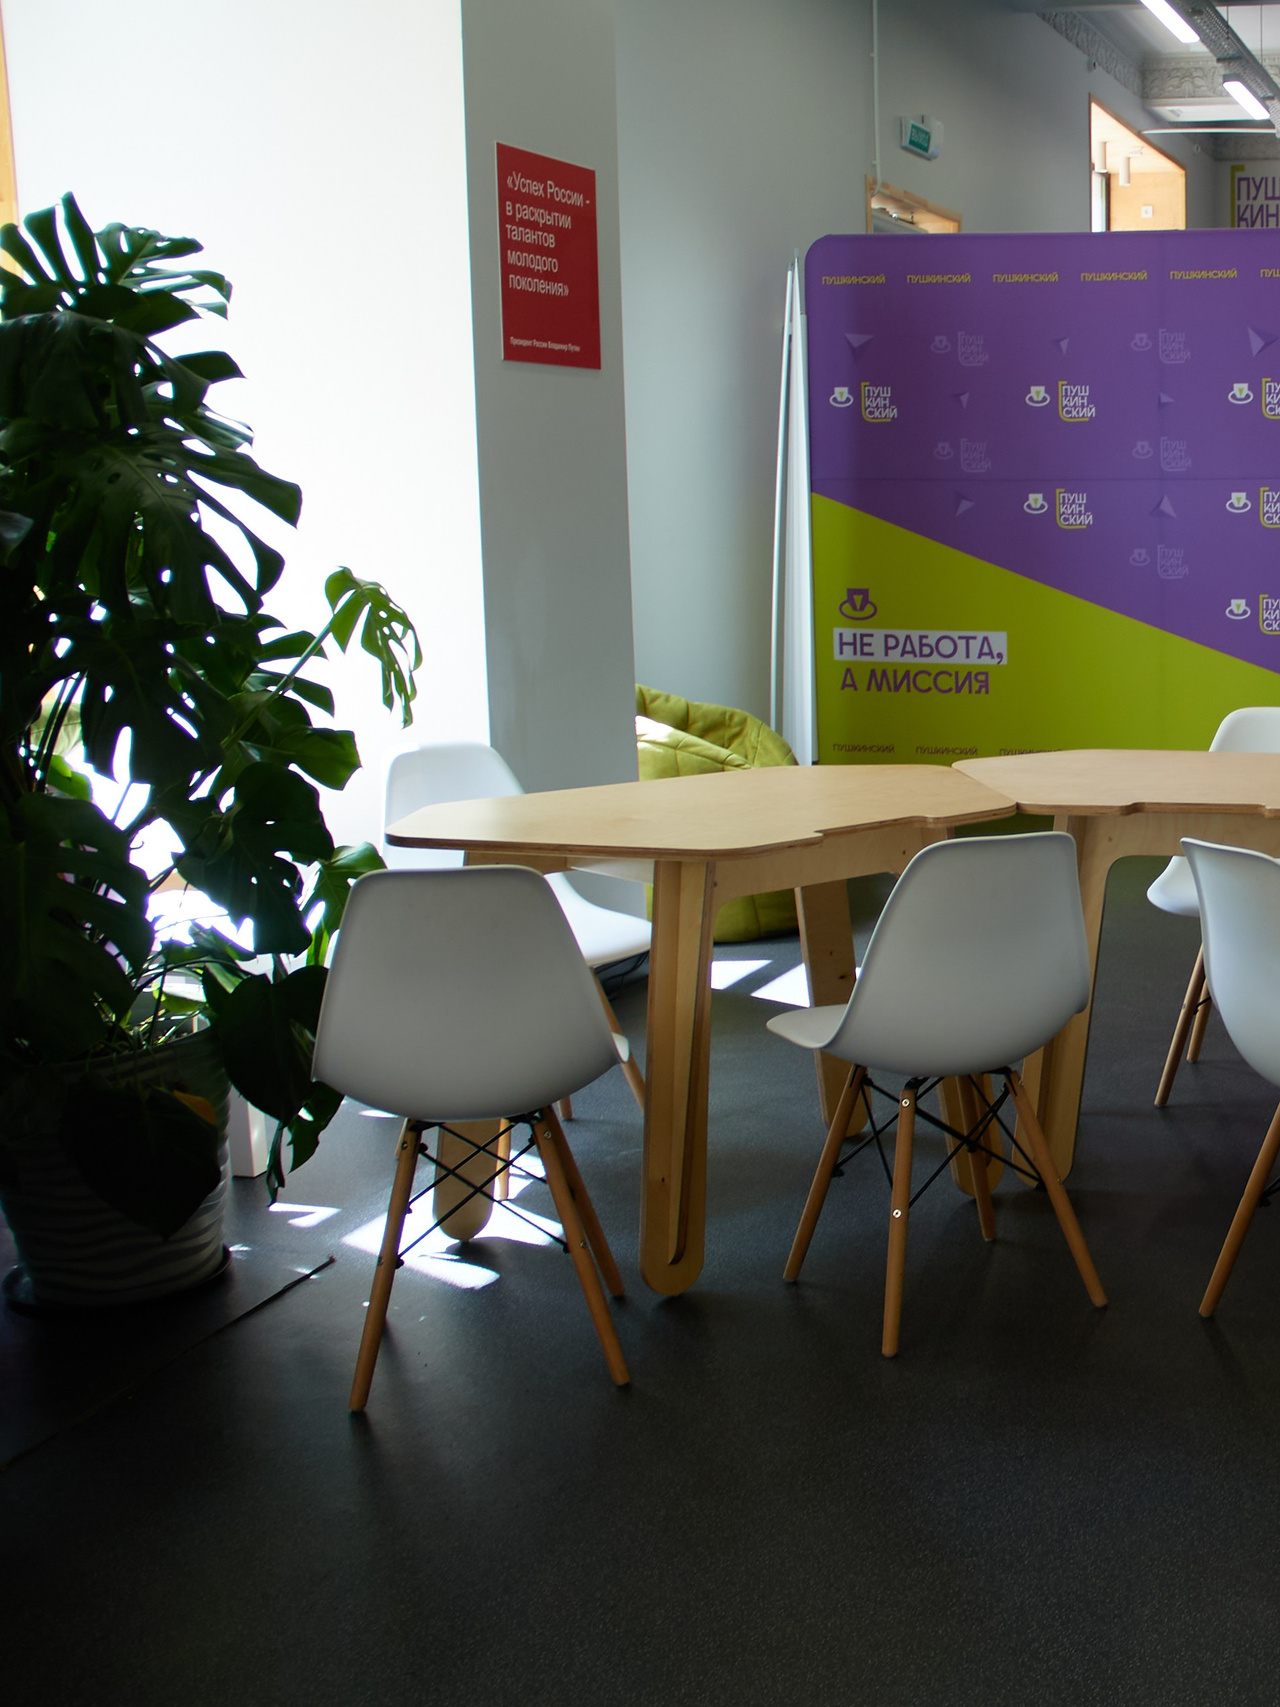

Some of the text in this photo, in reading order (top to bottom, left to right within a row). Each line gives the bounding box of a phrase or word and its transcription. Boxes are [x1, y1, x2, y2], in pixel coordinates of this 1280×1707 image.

[507, 171, 544, 198] «Успех
[547, 180, 584, 207] России
[506, 200, 572, 229] в раскрытии
[1237, 204, 1279, 228] КИН
[506, 224, 556, 248] талантов
[508, 250, 558, 273] молодого
[822, 274, 886, 285] ПУШКИНСКИЙ
[906, 274, 971, 284] ПУШКИНСКИЙ
[993, 272, 1058, 282] ПУШКИНСКИЙ
[1080, 271, 1147, 282] ПУШКИНСКИЙ
[1170, 269, 1238, 280] ПУШКИНСКИЙ
[509, 274, 570, 296] поколения»
[865, 386, 891, 396] ПУШ
[1062, 386, 1089, 396] ПУШ
[865, 397, 889, 407] КИН
[1062, 396, 1087, 406] КИН
[866, 406, 897, 418] СКИЙ
[1063, 404, 1096, 417] СКИЙ
[1060, 492, 1086, 504] ПУШ
[1060, 504, 1084, 514] КИН
[1060, 512, 1093, 524] СКИЙ
[839, 633, 1003, 664] НЕ РАБОТА,
[841, 668, 990, 694] А МИССИЯ
[833, 744, 895, 753] ПУШКИНСКИЙ
[916, 746, 978, 755] ПУШКИНСКИЙ
